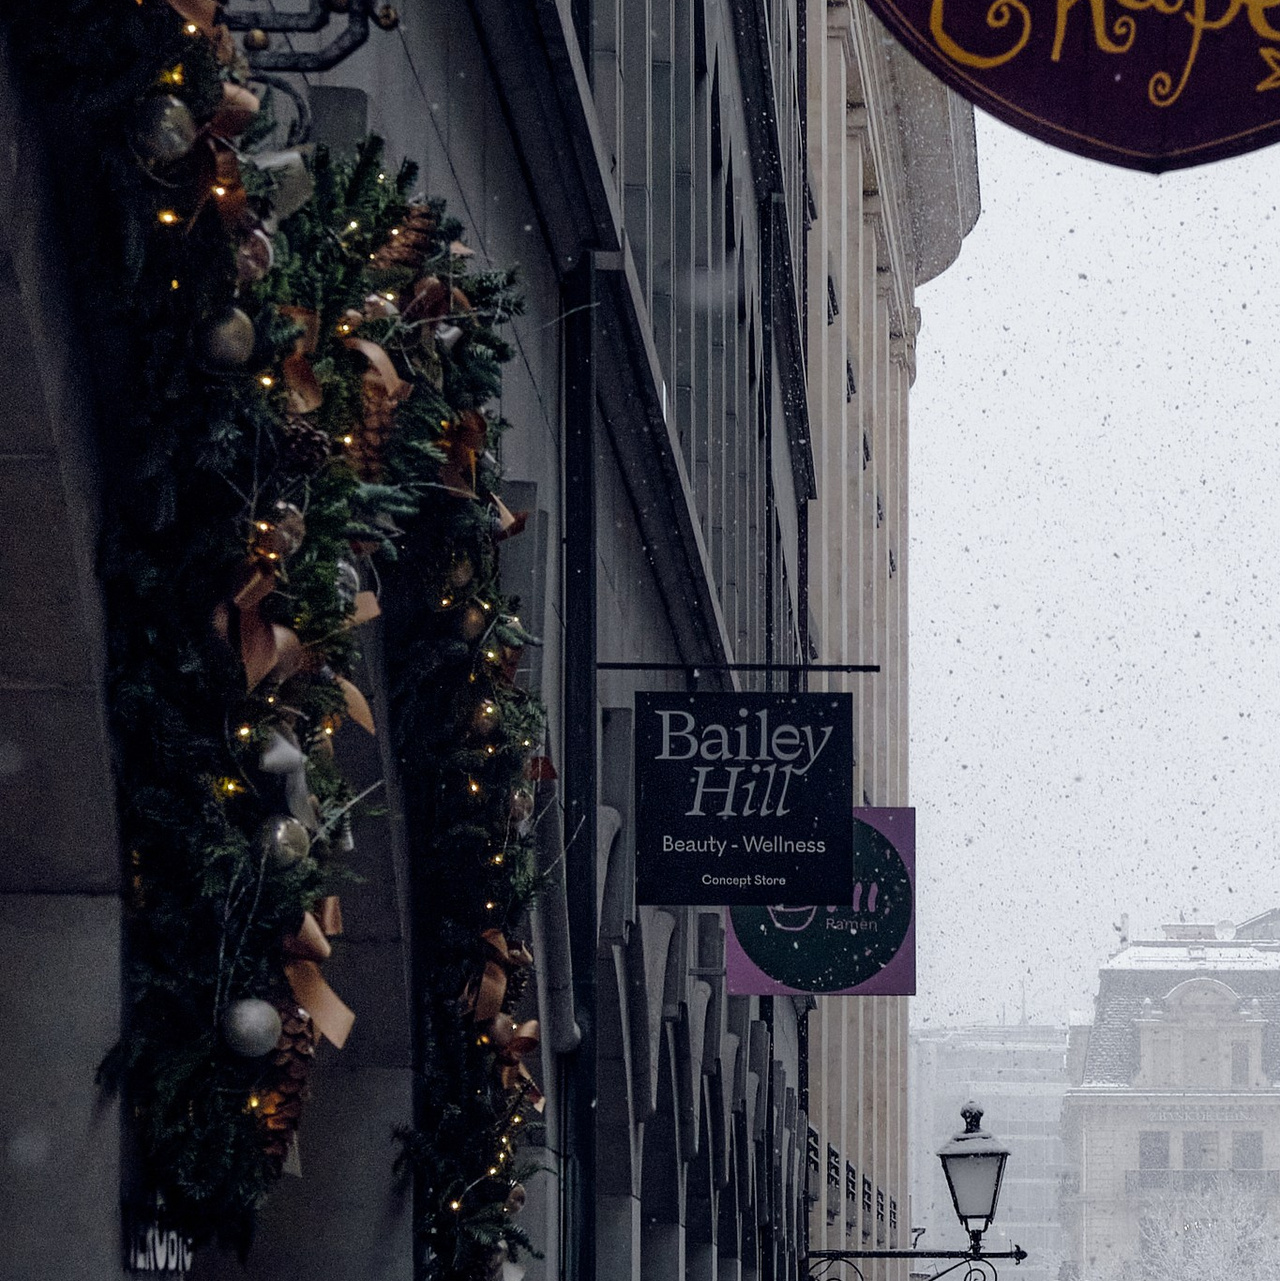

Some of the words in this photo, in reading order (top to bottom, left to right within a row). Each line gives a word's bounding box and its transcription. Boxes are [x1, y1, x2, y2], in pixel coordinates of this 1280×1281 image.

[654, 708, 834, 776] Bailey
[685, 763, 794, 817] Hill
[662, 835, 727, 857] Beauty
[742, 835, 827, 853] Wellness
[701, 874, 752, 888] Concept
[754, 874, 787, 886] Store
[825, 917, 878, 932] Ramen
